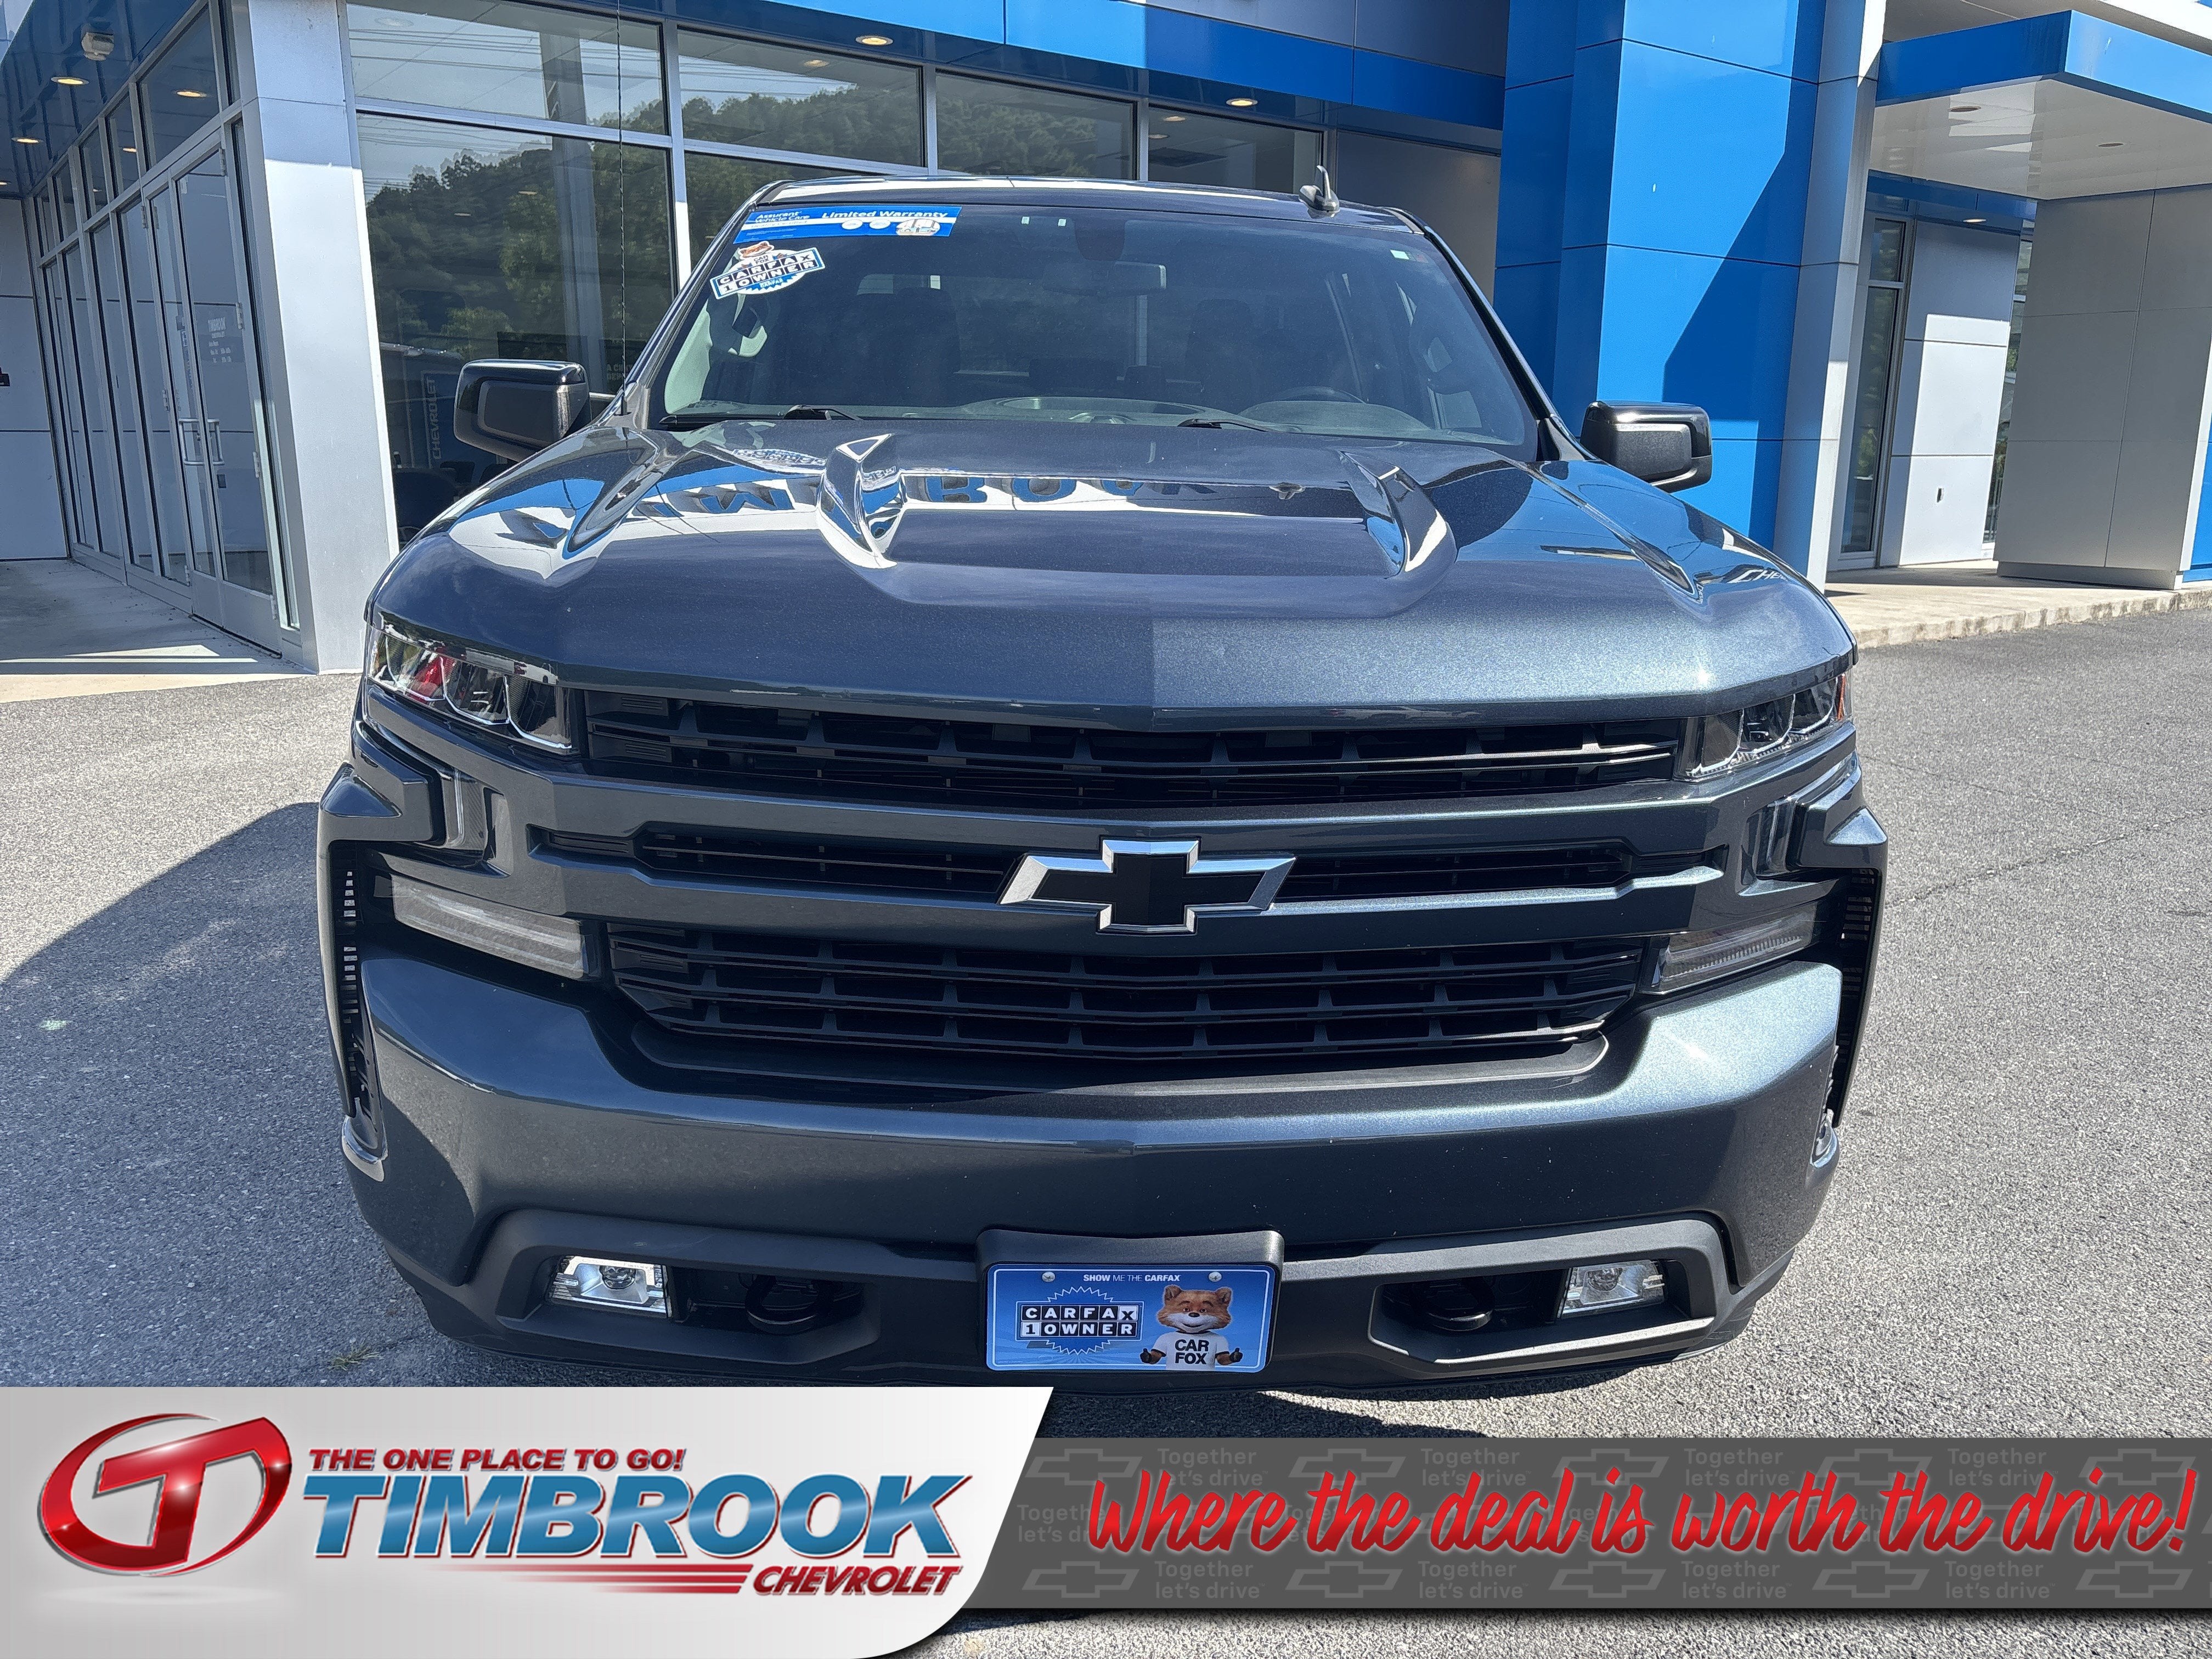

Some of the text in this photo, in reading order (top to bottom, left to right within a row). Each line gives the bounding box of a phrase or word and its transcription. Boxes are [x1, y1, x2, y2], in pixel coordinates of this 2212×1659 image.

[821, 211, 877, 219] Limited
[718, 253, 812, 285] CARFAX
[1024, 1307, 1136, 1321] CARFAX
[1175, 1339, 1209, 1352] CAR
[1175, 1352, 1207, 1364] FOX
